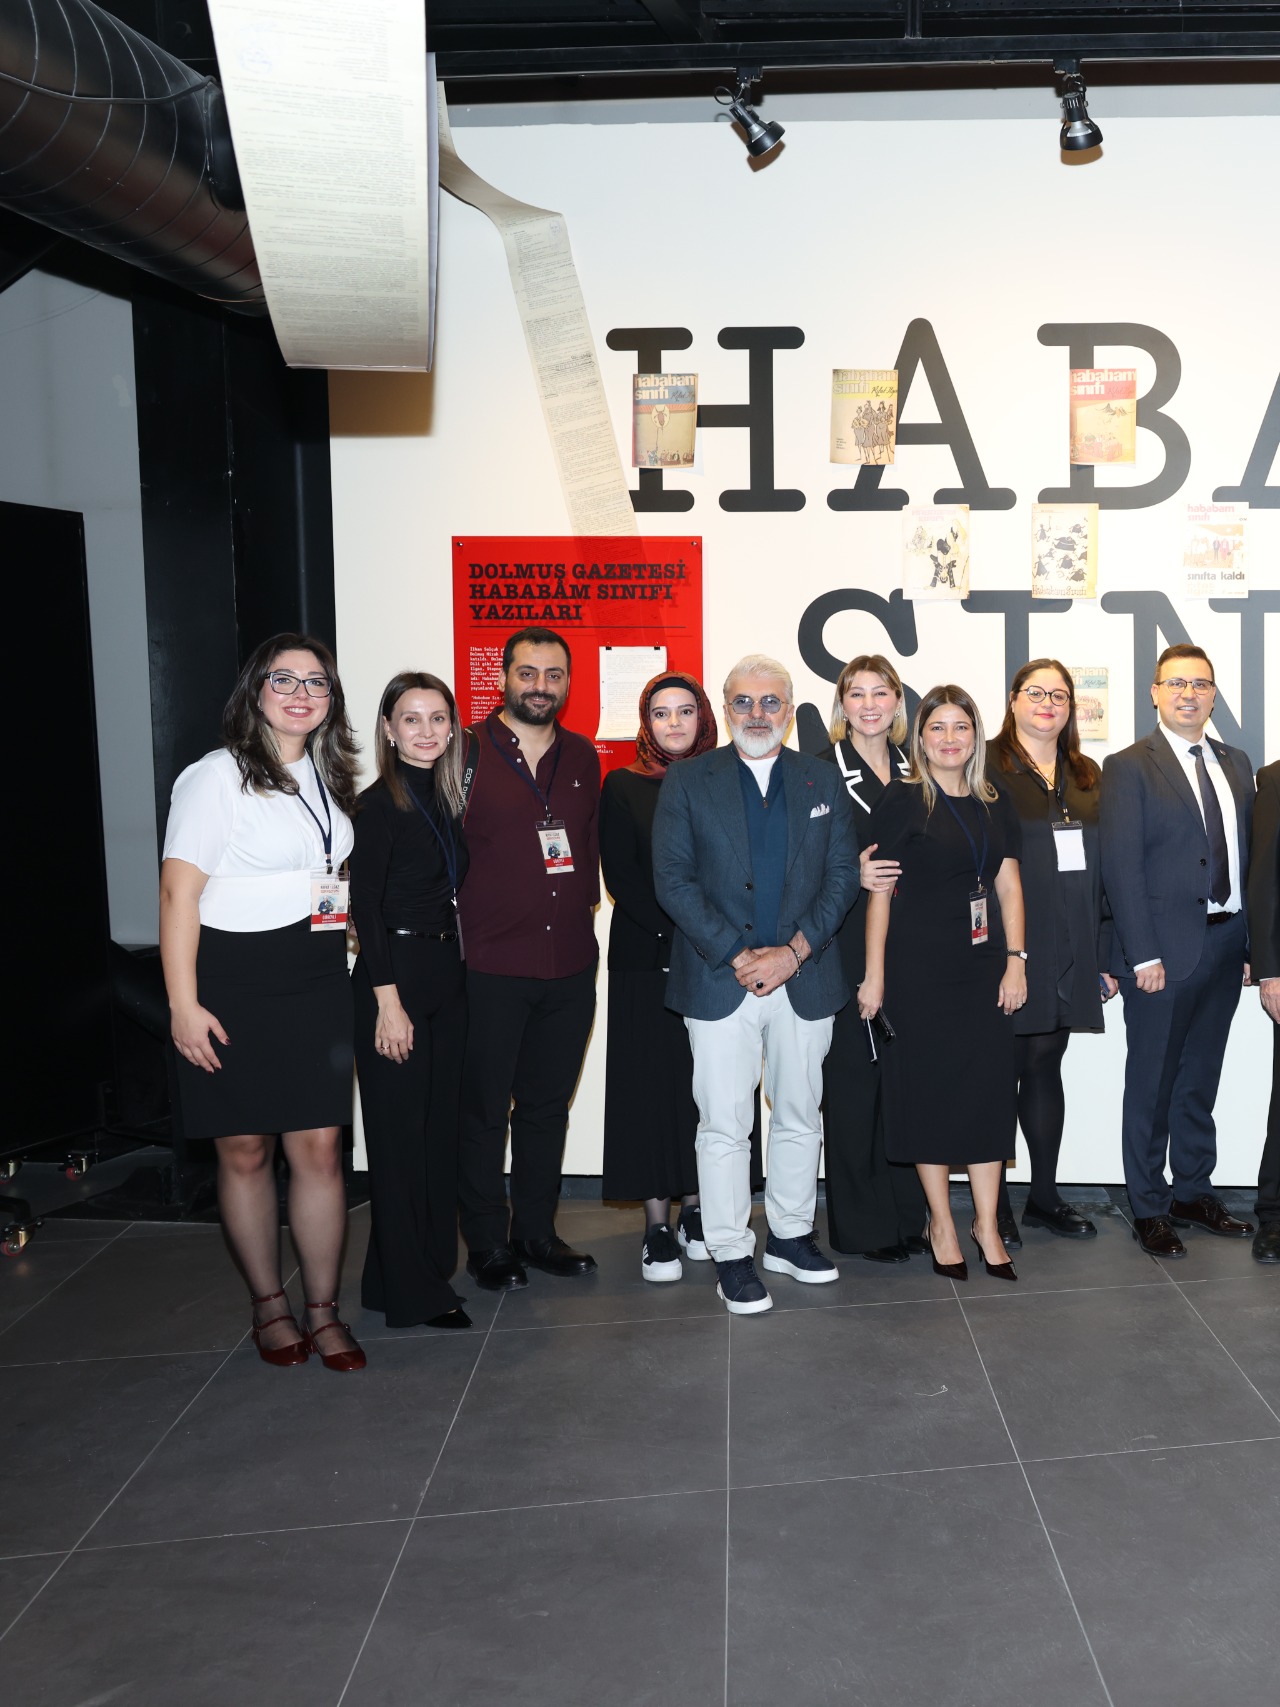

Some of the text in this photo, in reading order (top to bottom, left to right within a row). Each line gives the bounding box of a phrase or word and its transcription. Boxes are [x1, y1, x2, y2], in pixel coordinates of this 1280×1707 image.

[469, 559, 686, 583] DOLMUŞ GAZETESİ
[469, 584, 673, 600] HABABAM SINIFI
[469, 605, 583, 620] YAZILARI
